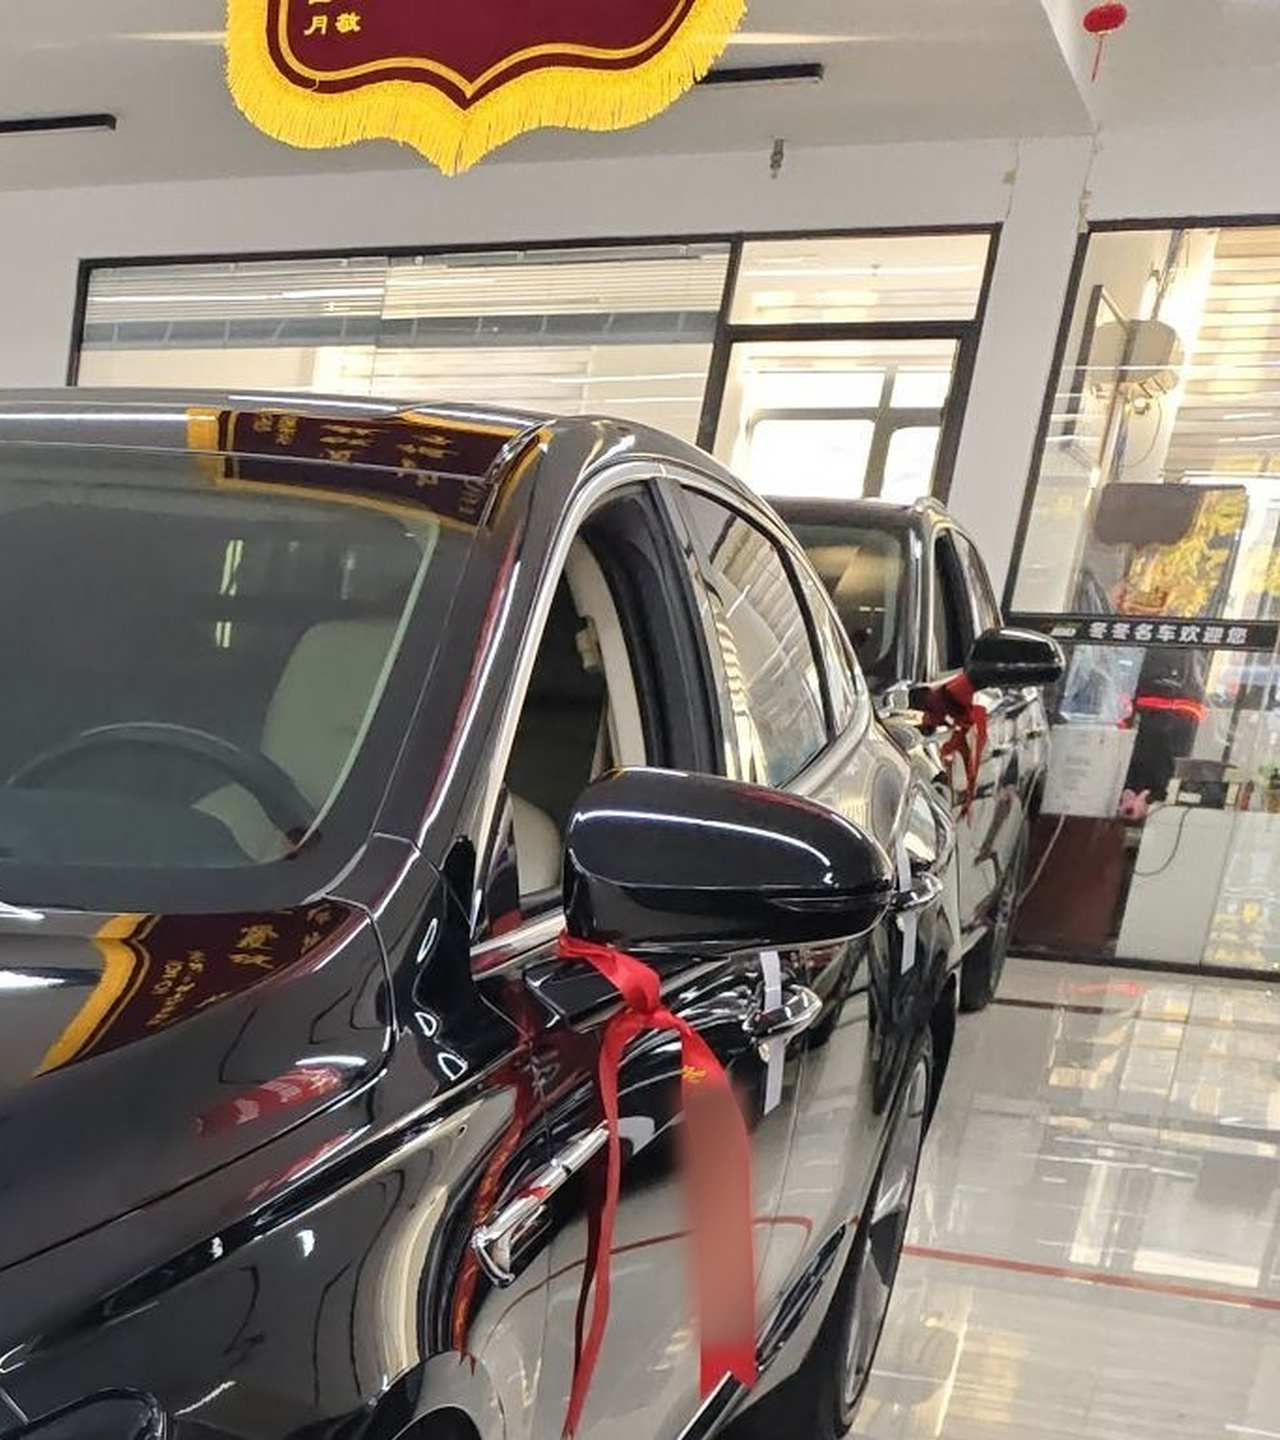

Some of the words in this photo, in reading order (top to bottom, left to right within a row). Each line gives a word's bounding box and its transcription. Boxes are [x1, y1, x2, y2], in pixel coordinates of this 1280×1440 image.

[1089, 621, 1249, 645] 冬冬名车欢迎您
